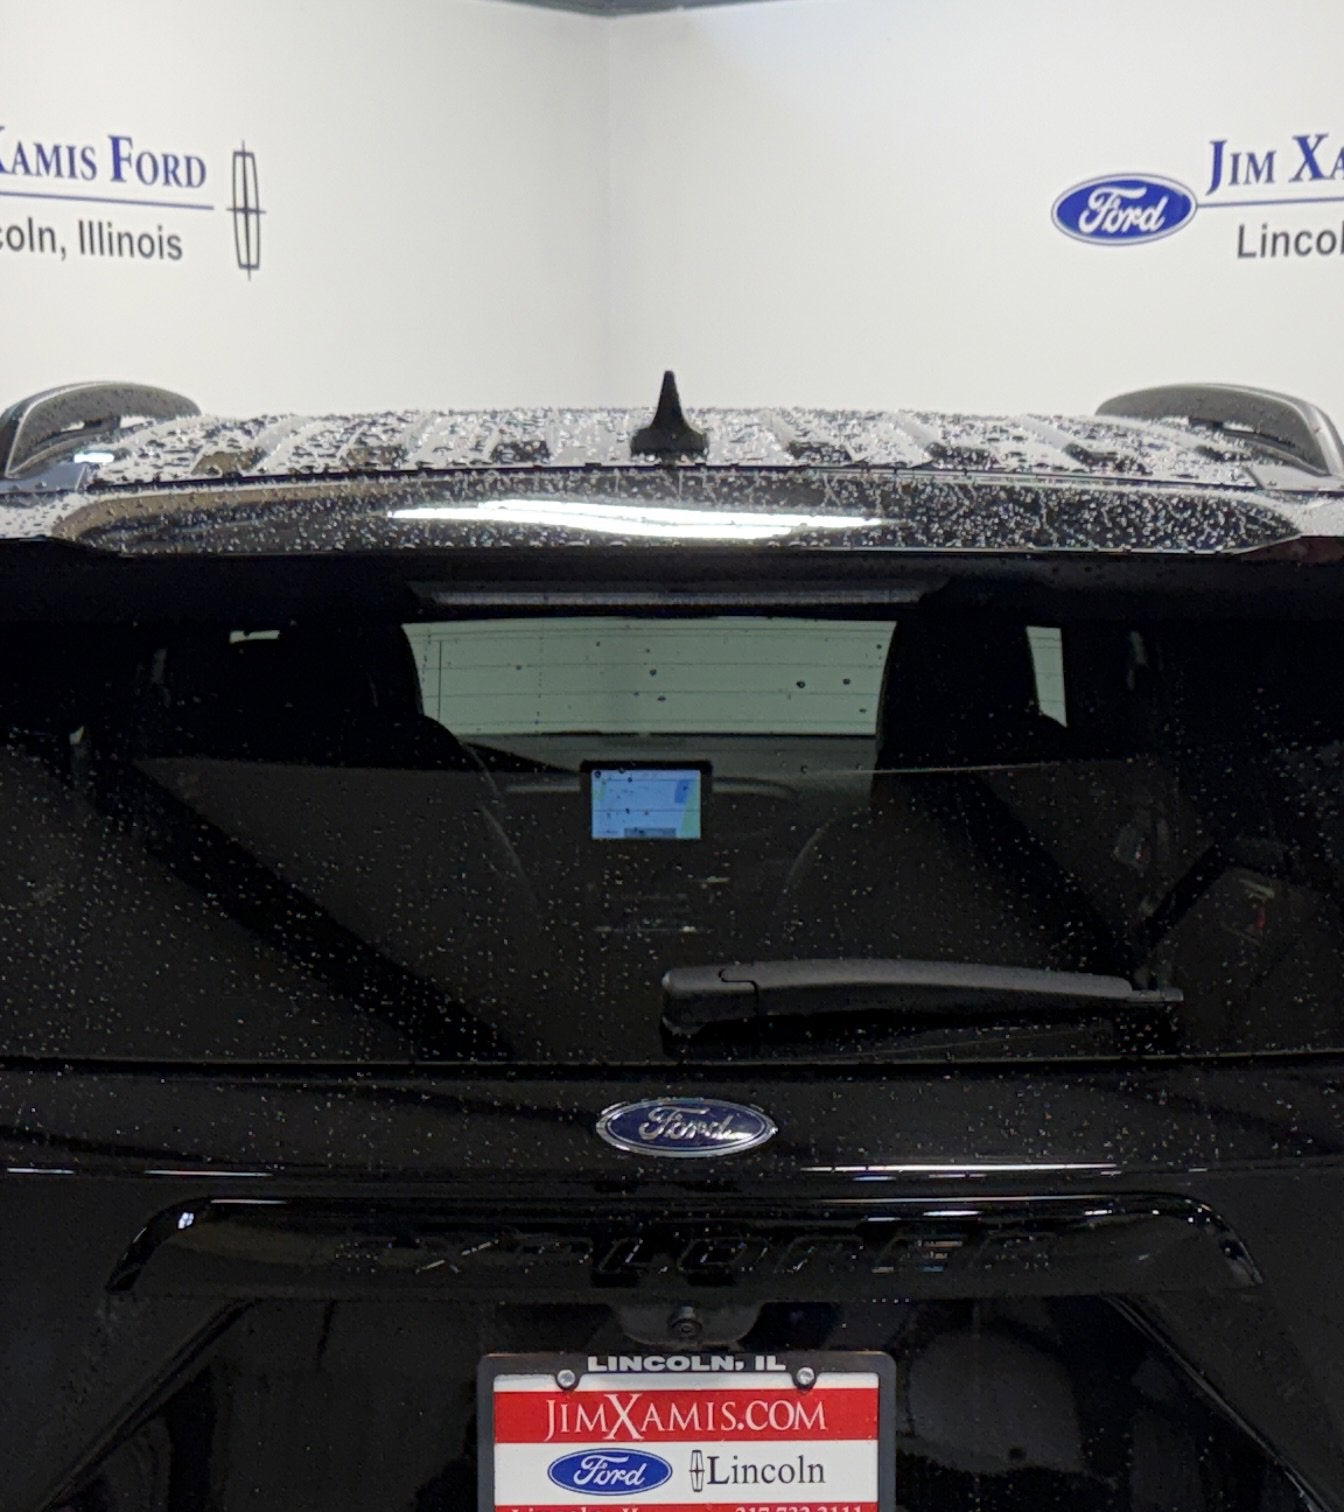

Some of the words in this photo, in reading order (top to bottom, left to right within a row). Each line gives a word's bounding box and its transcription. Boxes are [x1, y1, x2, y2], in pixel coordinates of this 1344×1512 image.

[108, 135, 207, 189] FORD
[1206, 139, 1276, 196] JIM
[1079, 186, 1165, 236] Ford
[79, 221, 183, 261] Illinois
[587, 1356, 745, 1371] LINCOLN,
[755, 1356, 786, 1371] IL
[544, 1393, 827, 1441] JIMXAMIS.COM
[573, 1455, 646, 1487] Ford
[706, 1455, 826, 1485] Lincoln
